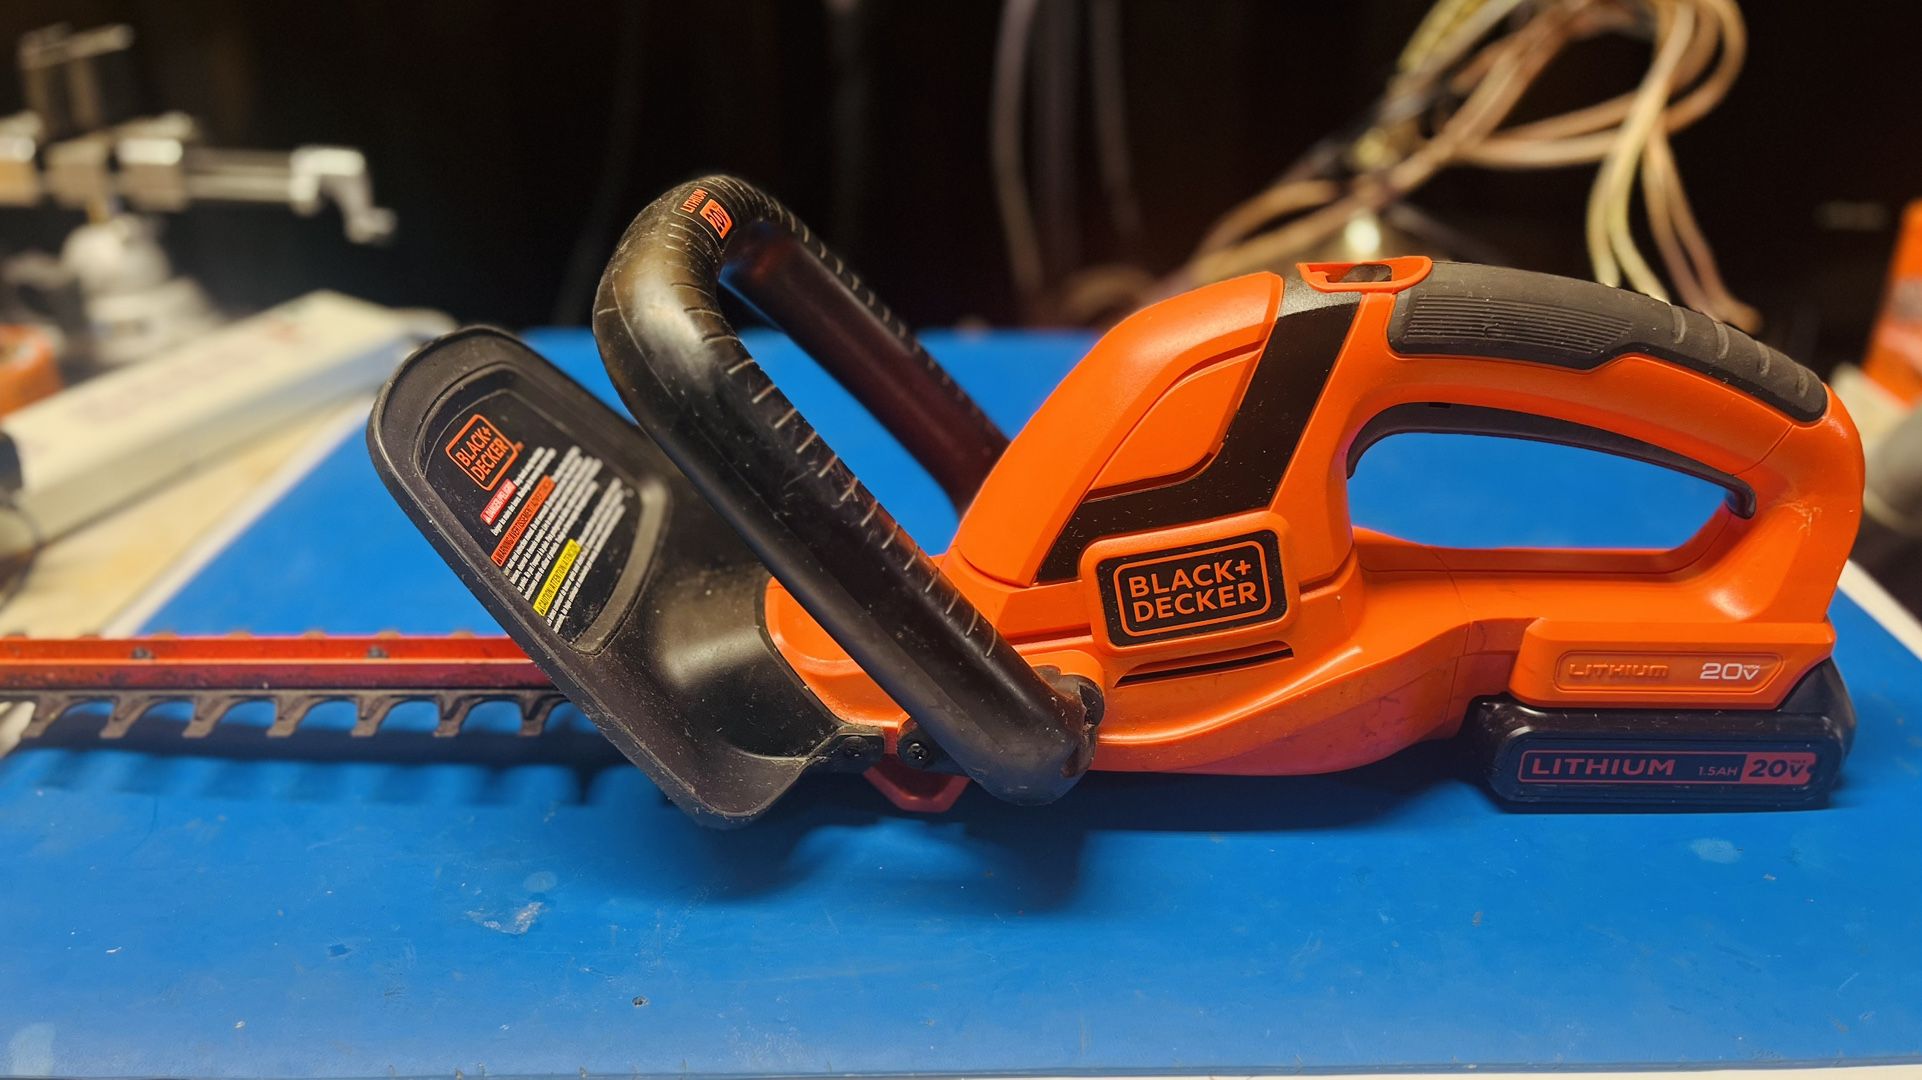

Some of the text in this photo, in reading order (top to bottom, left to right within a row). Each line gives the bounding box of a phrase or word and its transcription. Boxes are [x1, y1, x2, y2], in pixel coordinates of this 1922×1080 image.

[455, 426, 492, 467] BLACK+
[470, 437, 510, 481] DECKER
[1128, 559, 1251, 598] BLACK+
[1133, 581, 1258, 623] DECKER
[1569, 664, 1669, 676] LITHIUM
[1532, 758, 1676, 776] LITHIUM
[1699, 766, 1738, 776] 1.5AH
